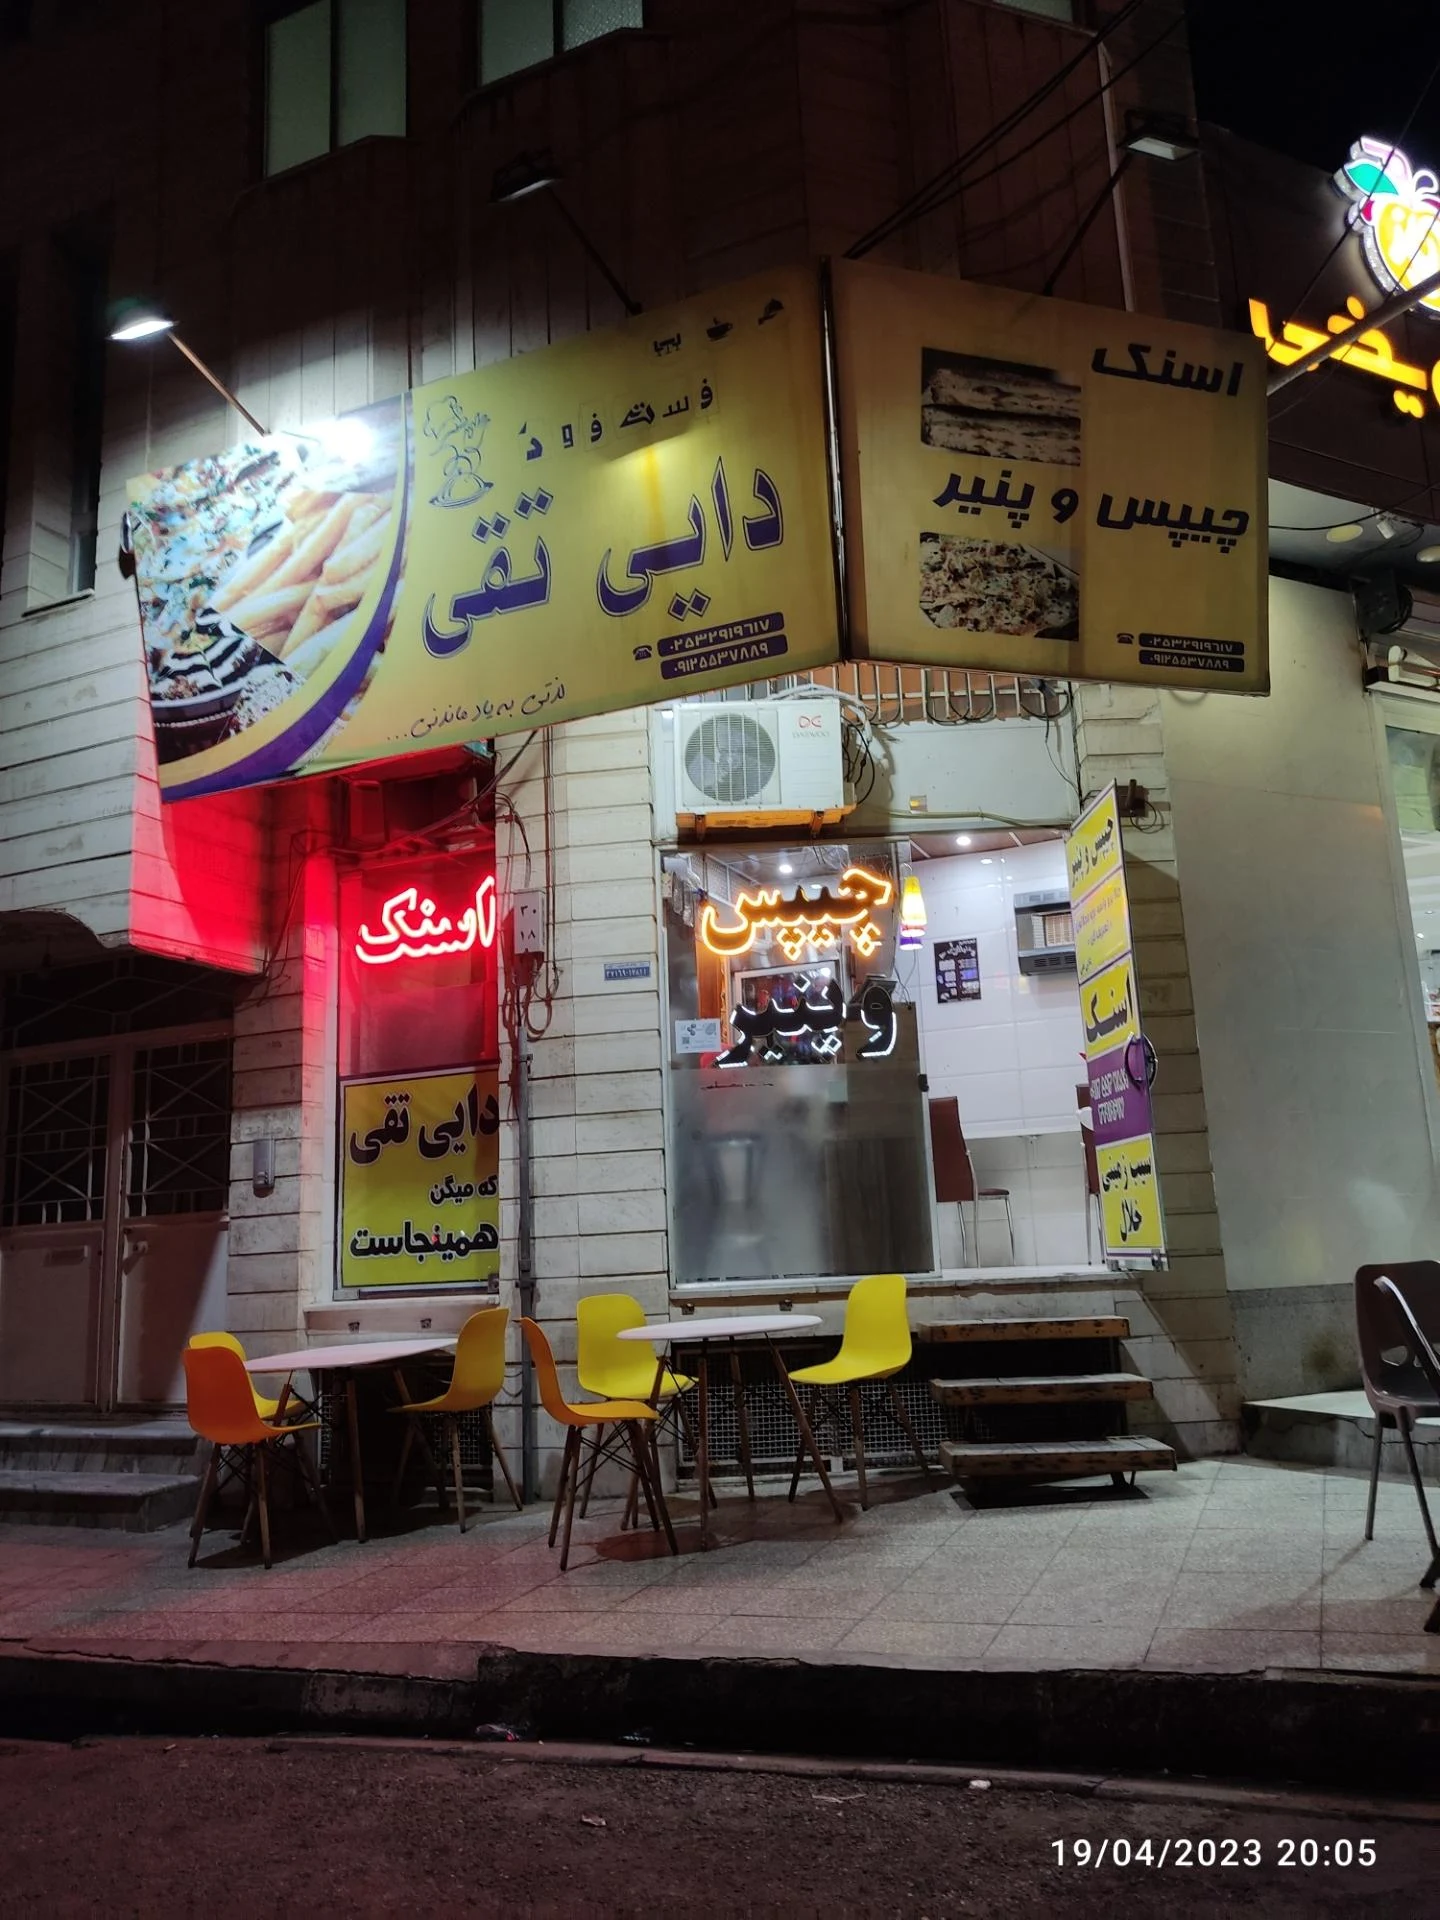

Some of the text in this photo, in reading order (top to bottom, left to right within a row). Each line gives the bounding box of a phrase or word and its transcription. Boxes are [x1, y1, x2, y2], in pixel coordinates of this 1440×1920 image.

[1091, 343, 1244, 397] اسنک
[933, 470, 1249, 553] چیپس و پنیر
[422, 456, 784, 660] دایی تقی
[674, 642, 769, 673] ۰۹۱۲۵۵۳۷۸۸۹
[701, 868, 894, 961] چیپس
[1086, 967, 1134, 1043] اسنک
[350, 1084, 500, 1165] دایی تقی
[430, 1175, 498, 1204] که میگن
[350, 1221, 499, 1262] همینجاست
